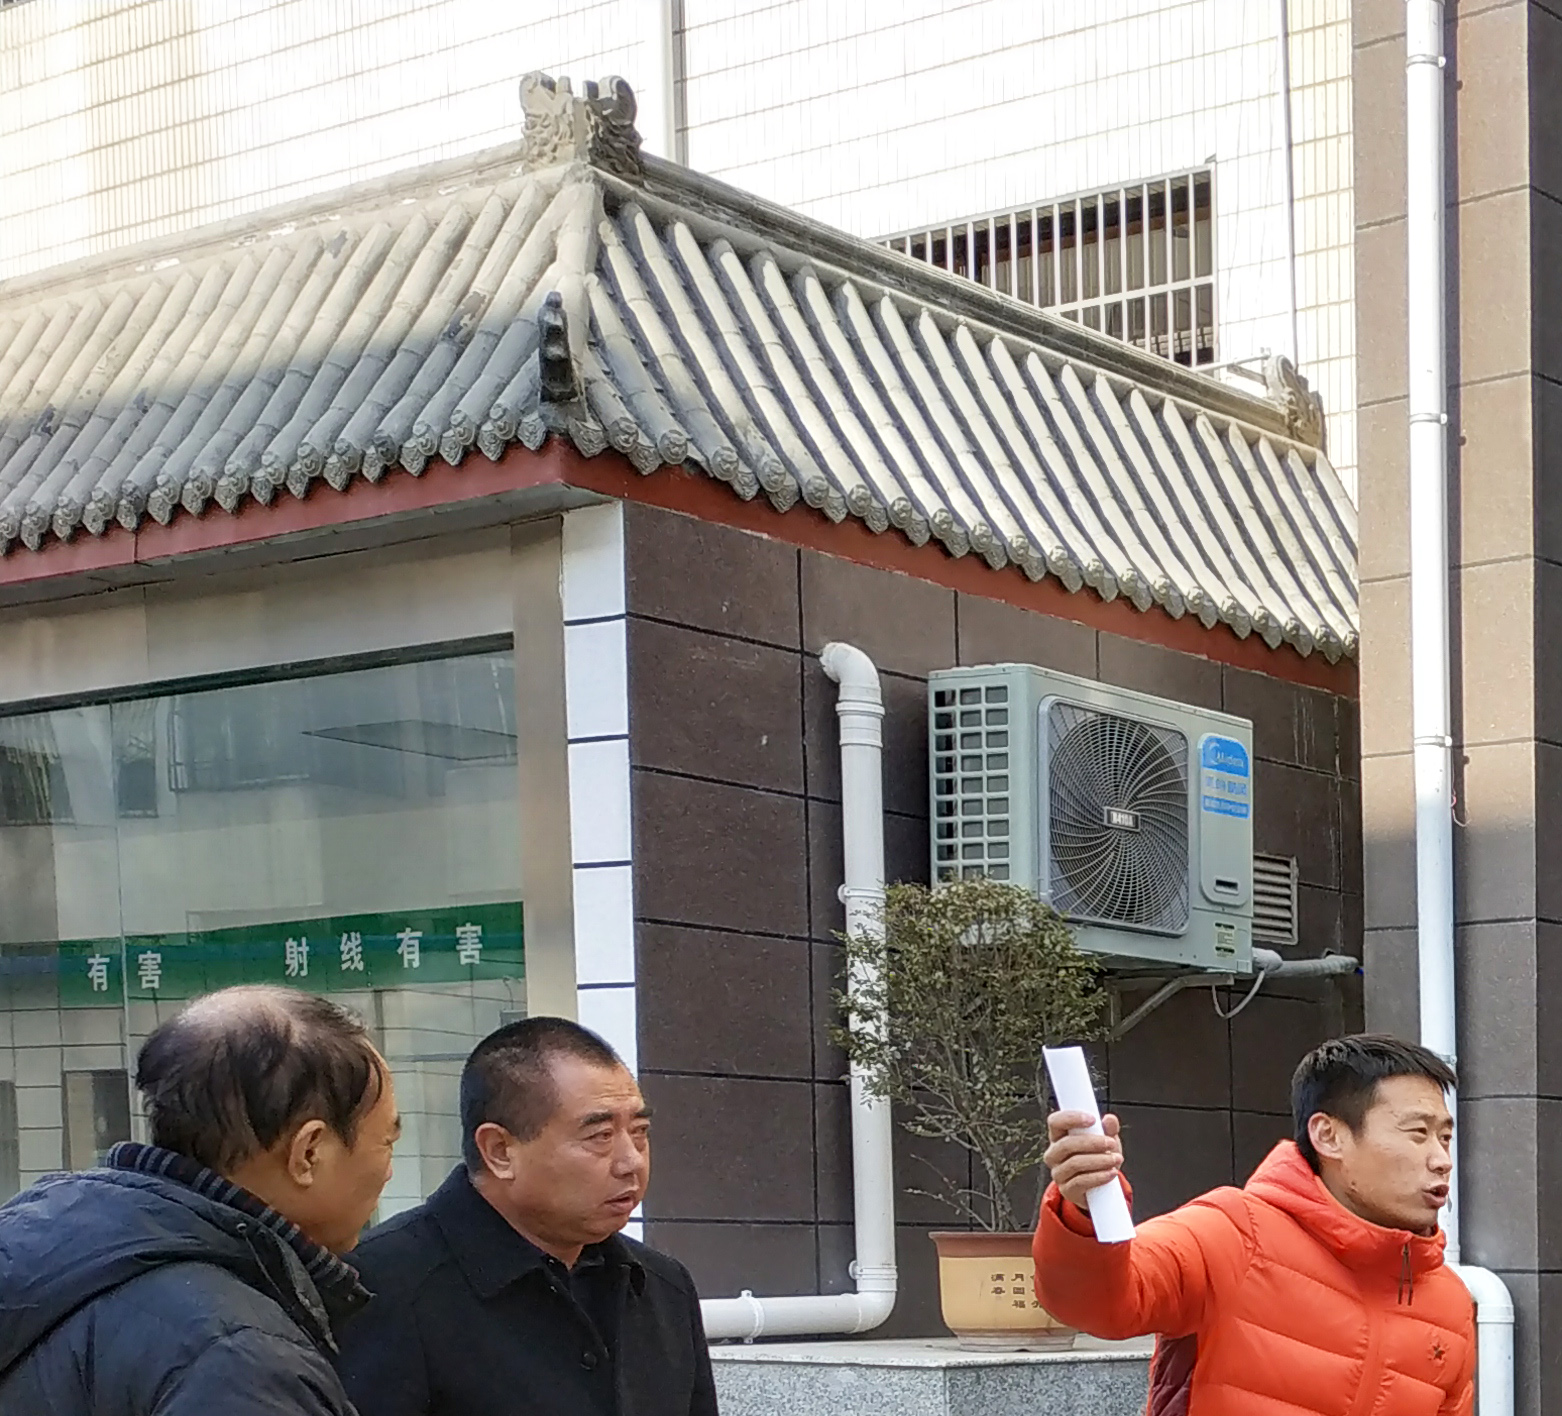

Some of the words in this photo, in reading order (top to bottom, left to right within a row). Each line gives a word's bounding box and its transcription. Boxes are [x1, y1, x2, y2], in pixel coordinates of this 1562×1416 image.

[87, 950, 163, 992] 有害
[284, 921, 484, 978] 射线有害
